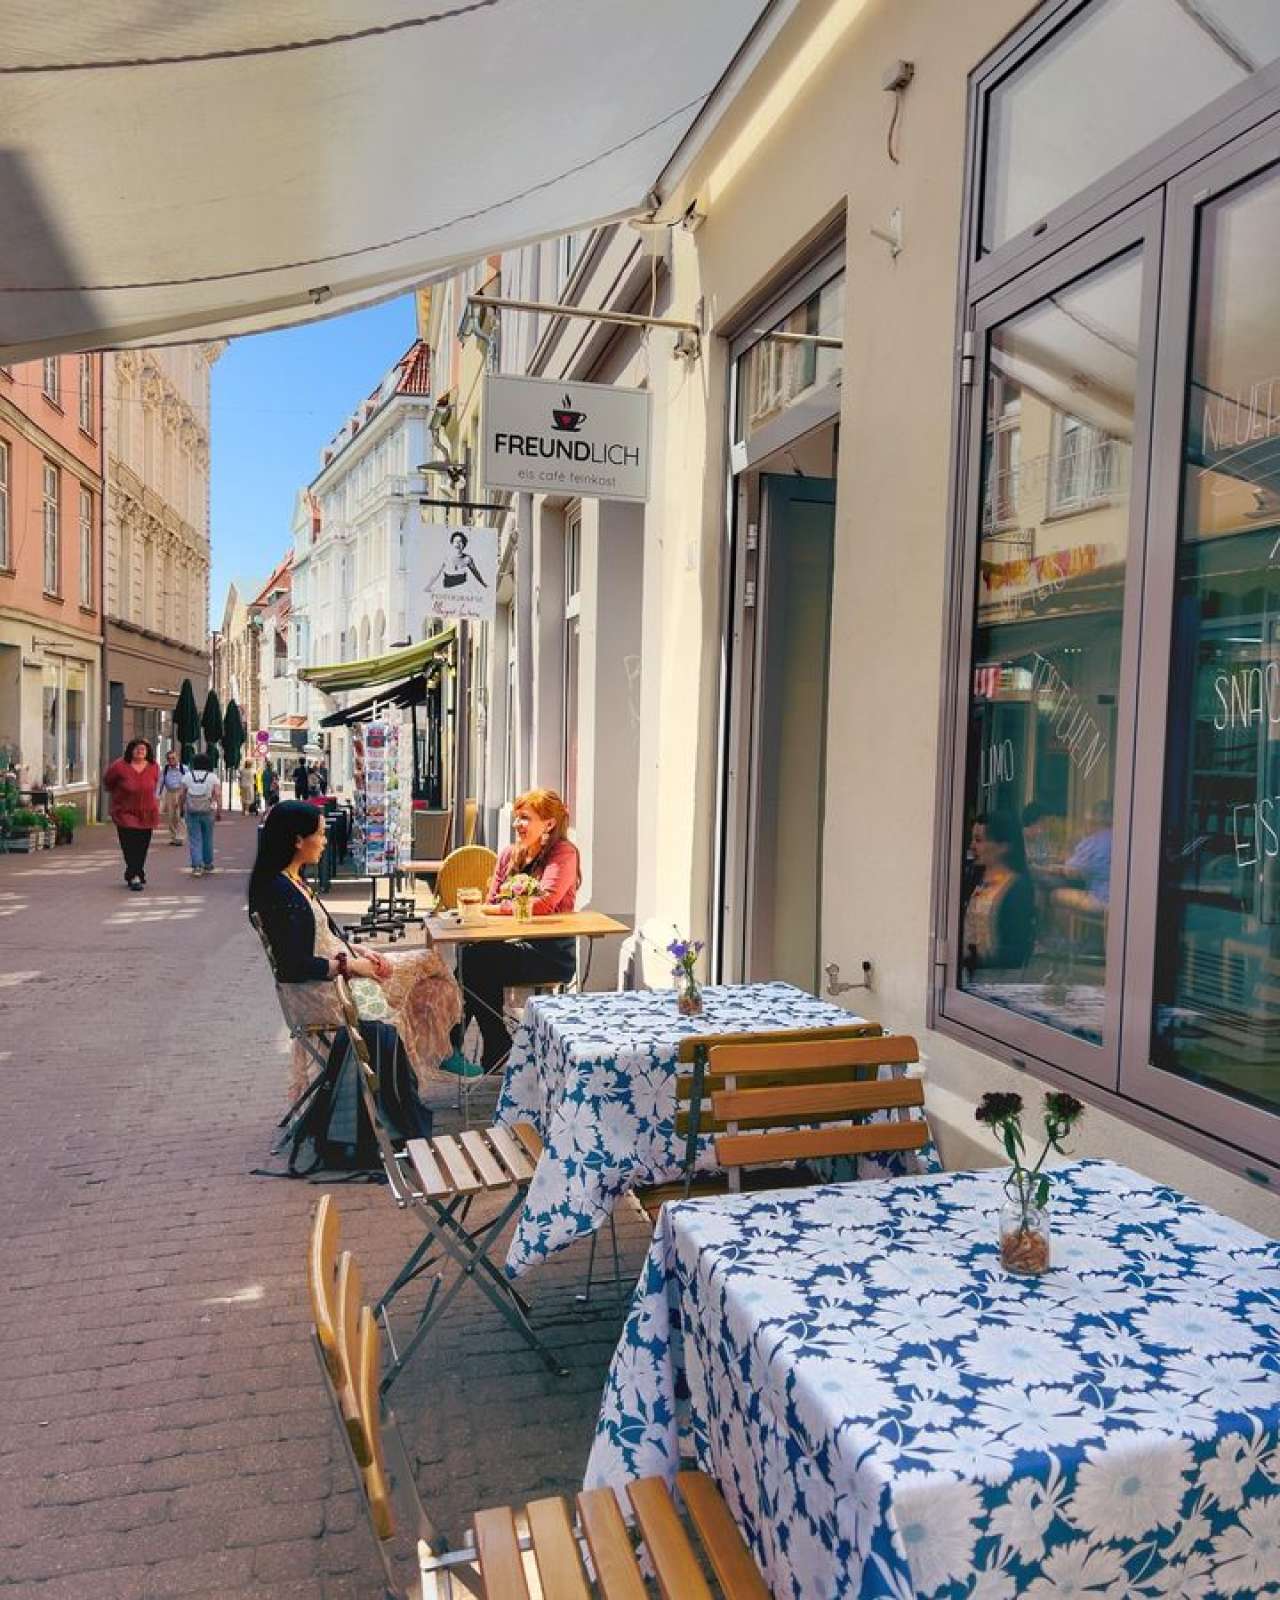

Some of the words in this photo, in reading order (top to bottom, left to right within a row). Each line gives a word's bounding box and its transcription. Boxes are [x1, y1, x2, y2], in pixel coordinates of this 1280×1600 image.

[494, 433, 640, 467] FREUNDLICH
[517, 468, 534, 481] eis
[570, 471, 616, 489] feinkost
[980, 738, 1014, 788] LIMO
